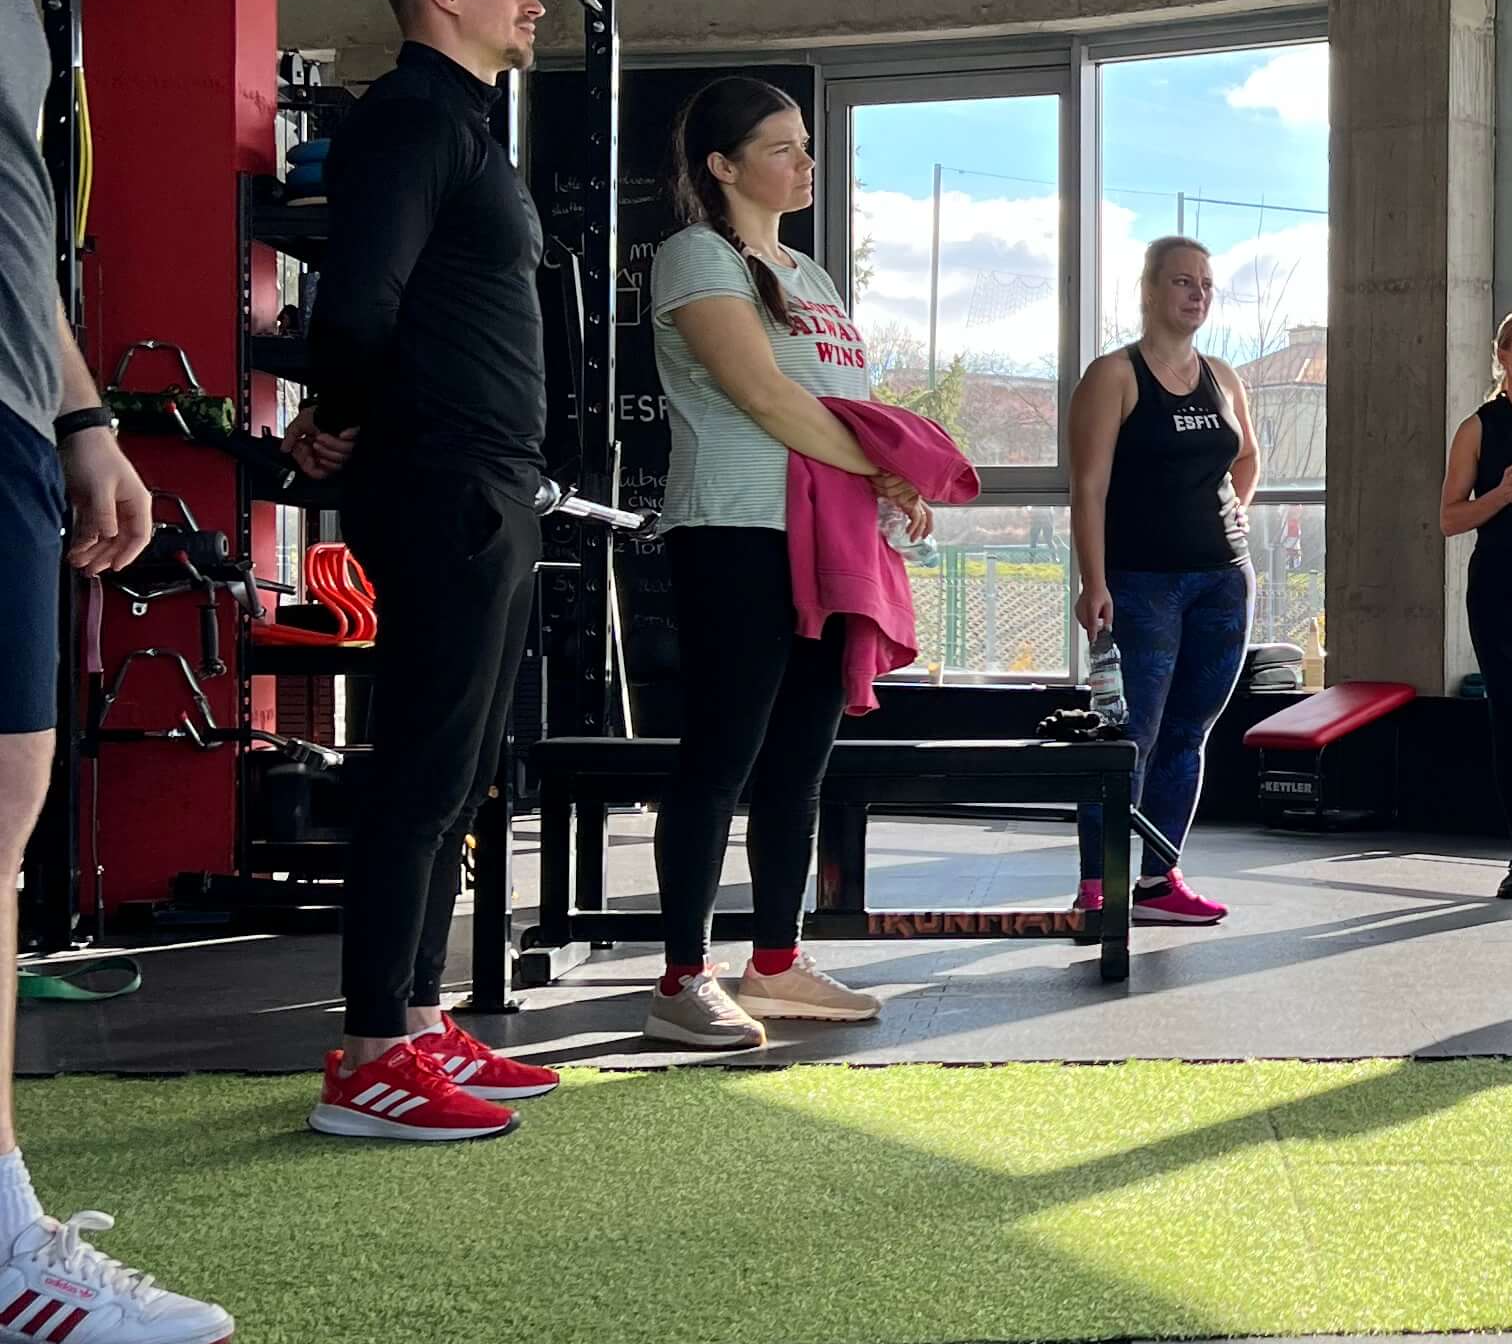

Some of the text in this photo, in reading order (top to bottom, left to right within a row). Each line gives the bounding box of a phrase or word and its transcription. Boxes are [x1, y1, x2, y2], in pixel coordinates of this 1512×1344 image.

[788, 315, 862, 342] ALWAY
[815, 342, 864, 369] WINS
[619, 394, 669, 422] ESF
[1173, 413, 1220, 432] ESFIT
[1264, 780, 1313, 794] KETTLER
